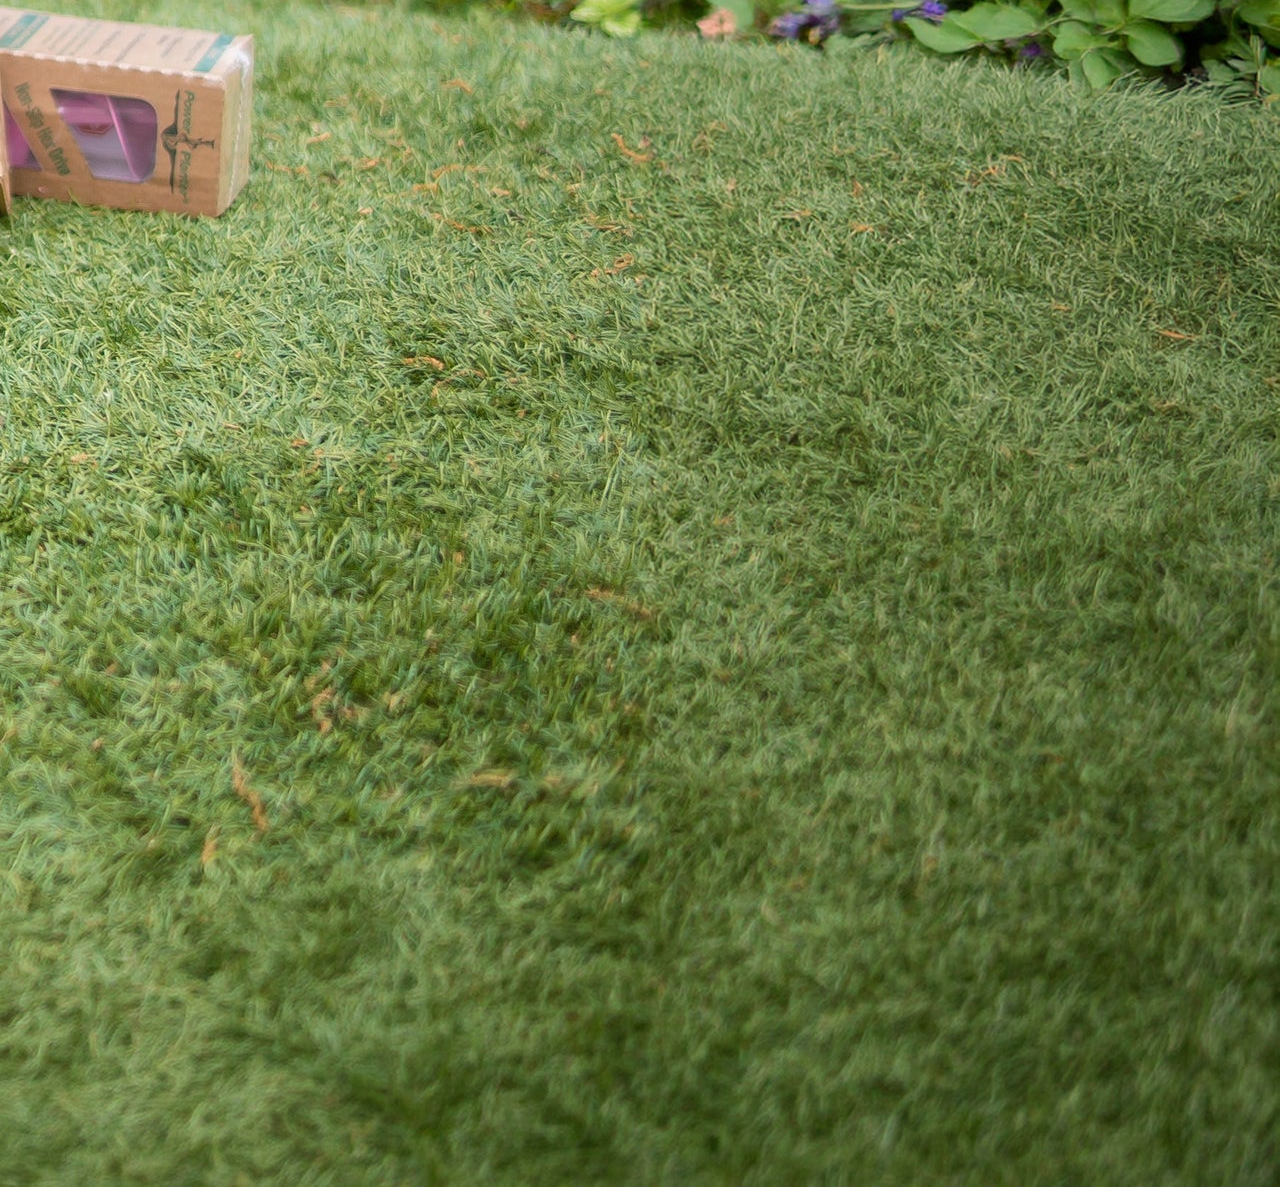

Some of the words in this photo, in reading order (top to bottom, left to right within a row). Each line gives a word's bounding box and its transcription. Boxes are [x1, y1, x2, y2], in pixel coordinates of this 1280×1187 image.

[14, 82, 45, 130] Non-Slip
[38, 123, 57, 150] Hex
[48, 147, 72, 176] Drive
[183, 90, 195, 134] Power
